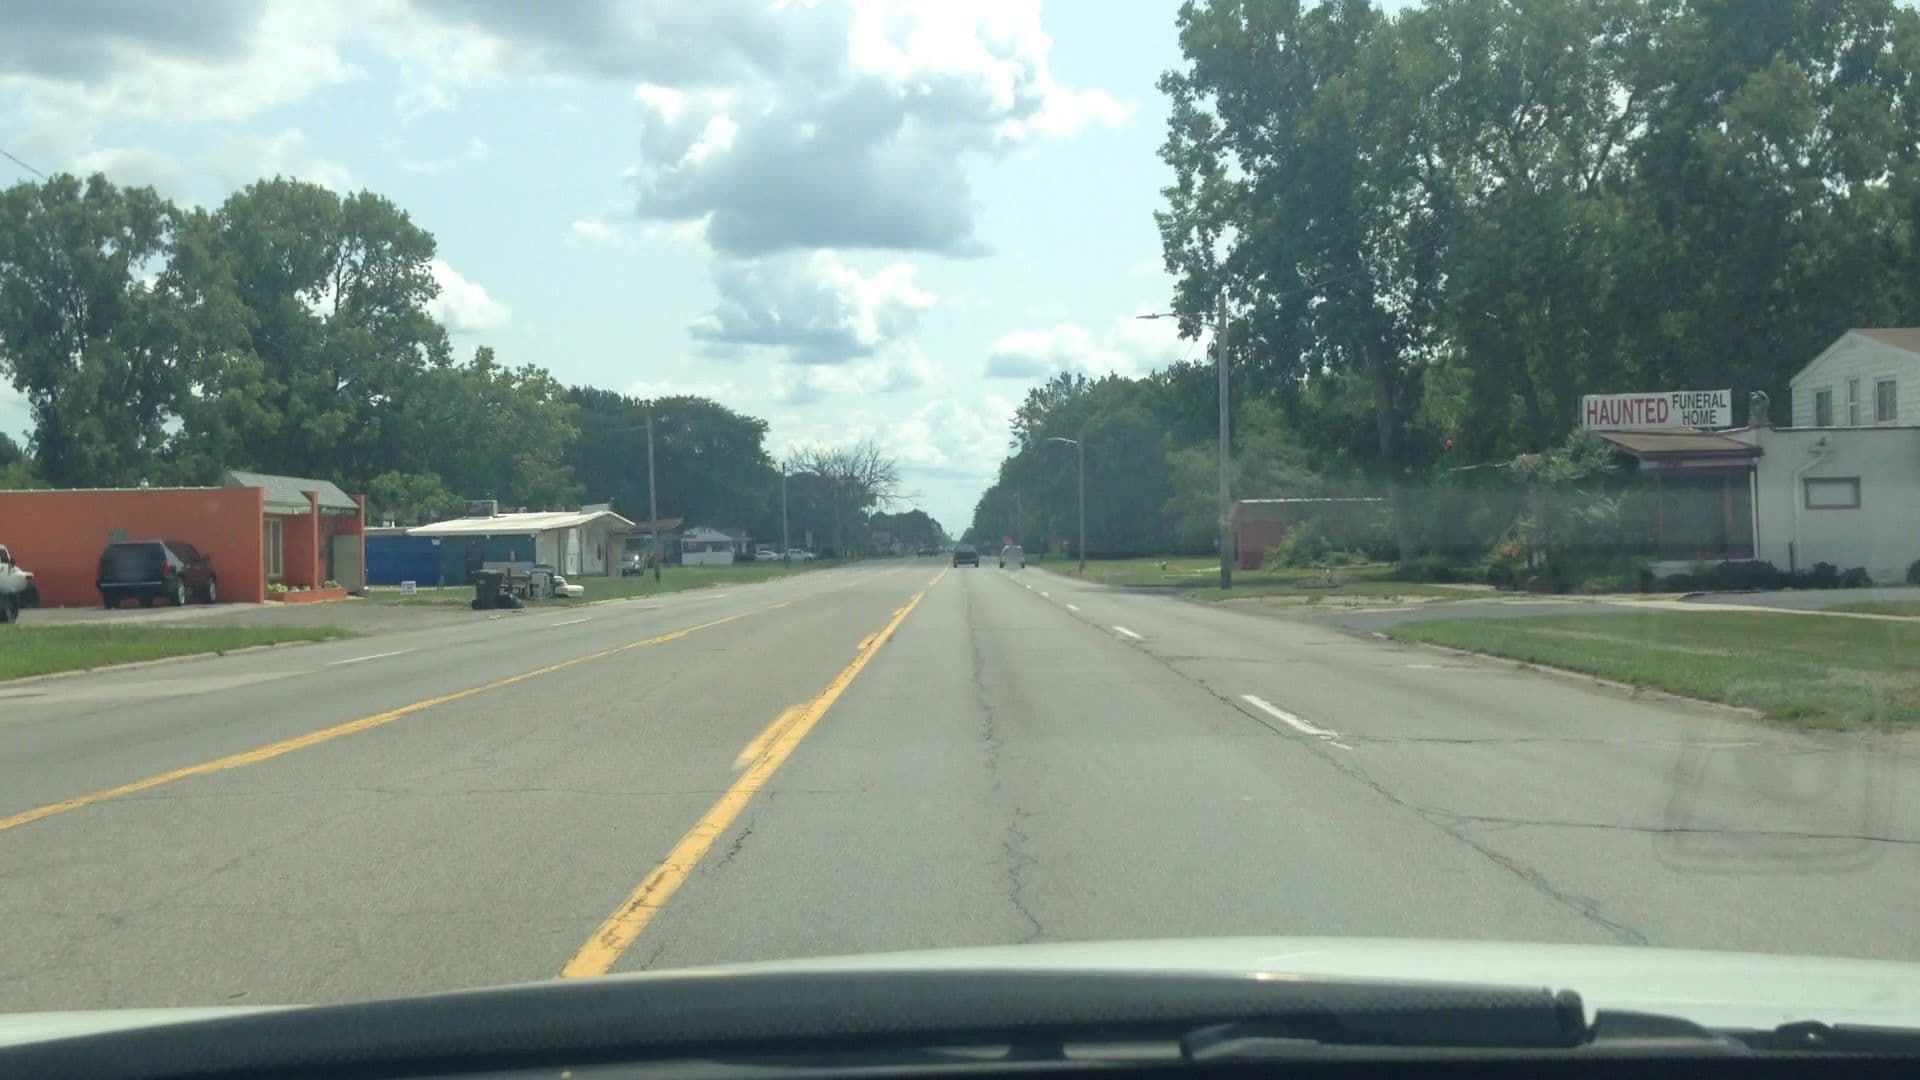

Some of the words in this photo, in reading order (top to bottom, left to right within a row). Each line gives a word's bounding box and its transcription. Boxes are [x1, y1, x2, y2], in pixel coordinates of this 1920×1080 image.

[1672, 393, 1727, 409] FUNERAL
[1587, 398, 1669, 424] HAUNTED
[1682, 410, 1717, 425] HOME
